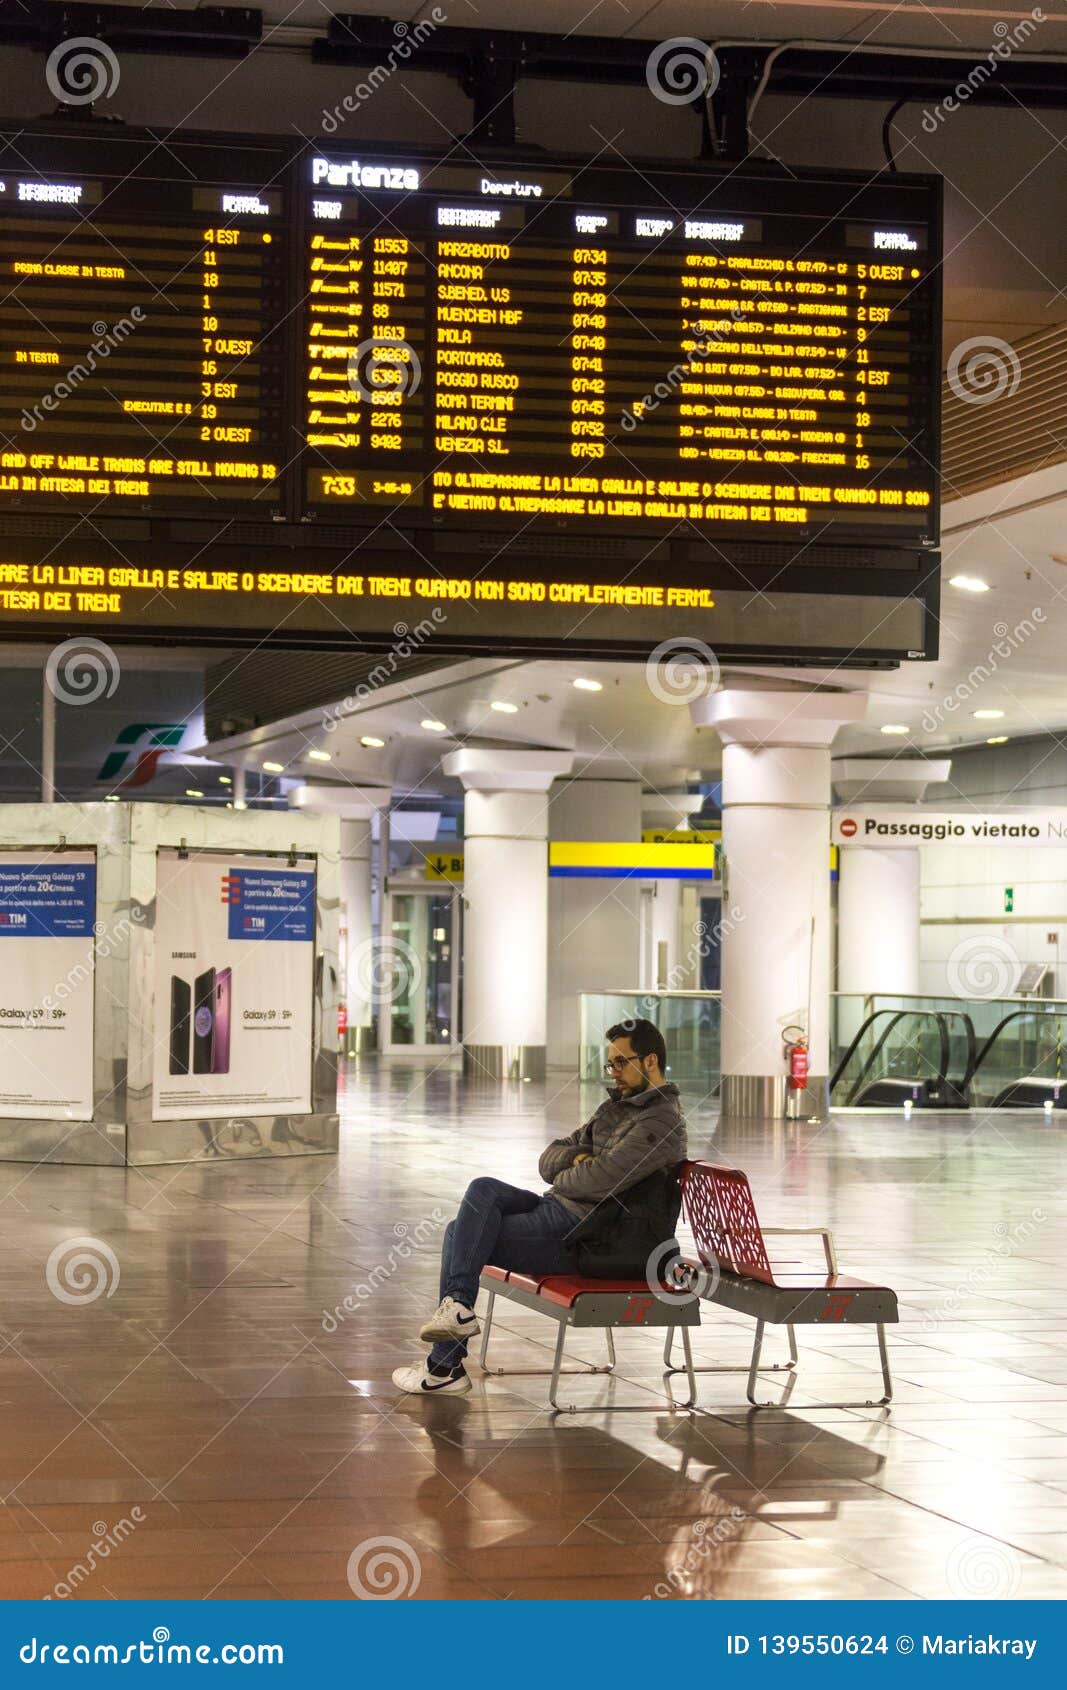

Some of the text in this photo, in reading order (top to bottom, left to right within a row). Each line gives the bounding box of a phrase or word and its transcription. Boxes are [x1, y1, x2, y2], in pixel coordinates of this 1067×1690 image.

[311, 157, 419, 191] Partenze
[481, 178, 543, 197] Departure
[204, 229, 240, 245] 4 EST
[204, 250, 217, 266] 11
[373, 238, 408, 254] 11563
[438, 241, 510, 260] MARZABOTTO
[573, 248, 607, 265] 07:34
[857, 264, 867, 279] 5
[14, 262, 125, 279] PRIMA CLASSE IN TESTA
[203, 272, 219, 288] 18
[373, 260, 867, 300] 11407 ANCONA 07:35 7
[203, 294, 211, 309] 1
[373, 281, 405, 298] 11571
[572, 291, 607, 308] 07:40
[857, 306, 867, 321] 2
[868, 307, 891, 322] EST
[203, 316, 218, 332] 10
[372, 303, 867, 343] 88 MUENCHEN HBF 07:40 9
[202, 338, 212, 353] 7
[372, 325, 869, 364] 11613 IMOLA 07:40 11
[15, 351, 60, 364] IN TESTA
[202, 360, 217, 376] 16
[571, 356, 603, 372] 07:41
[856, 370, 866, 384] 4
[868, 370, 890, 385] EST
[201, 382, 238, 399] 3 EST
[371, 368, 866, 405] 6396 POGGIO RUSCO 07:42 4
[123, 400, 175, 414] EXECUTIVE
[201, 404, 217, 419] 19
[436, 393, 467, 409] ROMA
[470, 394, 514, 411] TERMINI
[571, 399, 605, 415] 07:45
[856, 412, 871, 427] 18
[200, 426, 211, 441] 2
[370, 412, 402, 428] 2276
[435, 414, 478, 431] MILANO
[571, 420, 605, 437] 07:52
[855, 433, 863, 448] 1
[435, 436, 485, 453] VENEZIA
[571, 442, 605, 458] 07:53
[855, 454, 870, 469] 16
[1, 453, 27, 468] AND
[29, 454, 55, 469] OFF
[57, 455, 100, 472] WHILE
[102, 457, 146, 474] TRAINS
[176, 460, 212, 477] STILL
[214, 462, 259, 479] MOVING
[261, 464, 276, 479] IS
[21, 476, 150, 496] IN ATTESA DEI TRENI
[454, 472, 903, 505] OLTREPASSARE LA LINEA GIALLA E SALIRE O SCENDERE DAI TRENI QUANDO NON
[448, 494, 497, 511] VIETATO
[498, 496, 586, 514] OLTREPASSARE
[587, 499, 605, 515] LA
[607, 500, 643, 517] LINEA
[644, 501, 687, 519] GIALLA
[688, 503, 704, 519] IN
[705, 504, 748, 521] ATTESA
[750, 506, 771, 522] DEI
[773, 506, 808, 523] TRENI
[32, 565, 55, 585] LA
[57, 566, 105, 586] LINEA
[108, 567, 164, 588] GIALLA
[167, 570, 180, 589] E
[183, 570, 239, 591] SALIRE
[241, 572, 254, 592] O
[257, 573, 333, 594] SCENDERE
[336, 575, 364, 595] DAI
[367, 576, 412, 597] TRENI
[414, 578, 472, 599] QUANDO
[474, 580, 505, 600] NON
[507, 581, 546, 602] SONO
[548, 583, 664, 606] COMPLETAMENTE
[666, 587, 715, 608] FERMI.
[43, 591, 121, 613] DEI TRENI
[864, 819, 966, 840] Passaggio
[971, 821, 1041, 838] vietato
[21, 872, 51, 882] Samsung
[52, 872, 75, 882] Galaxy
[9, 913, 28, 925] TIM
[251, 917, 265, 928] TIM
[172, 951, 197, 959] SAMSUNG
[0, 1008, 67, 1021] Galaxy S9 S9+
[243, 1010, 267, 1021] Galaxy
